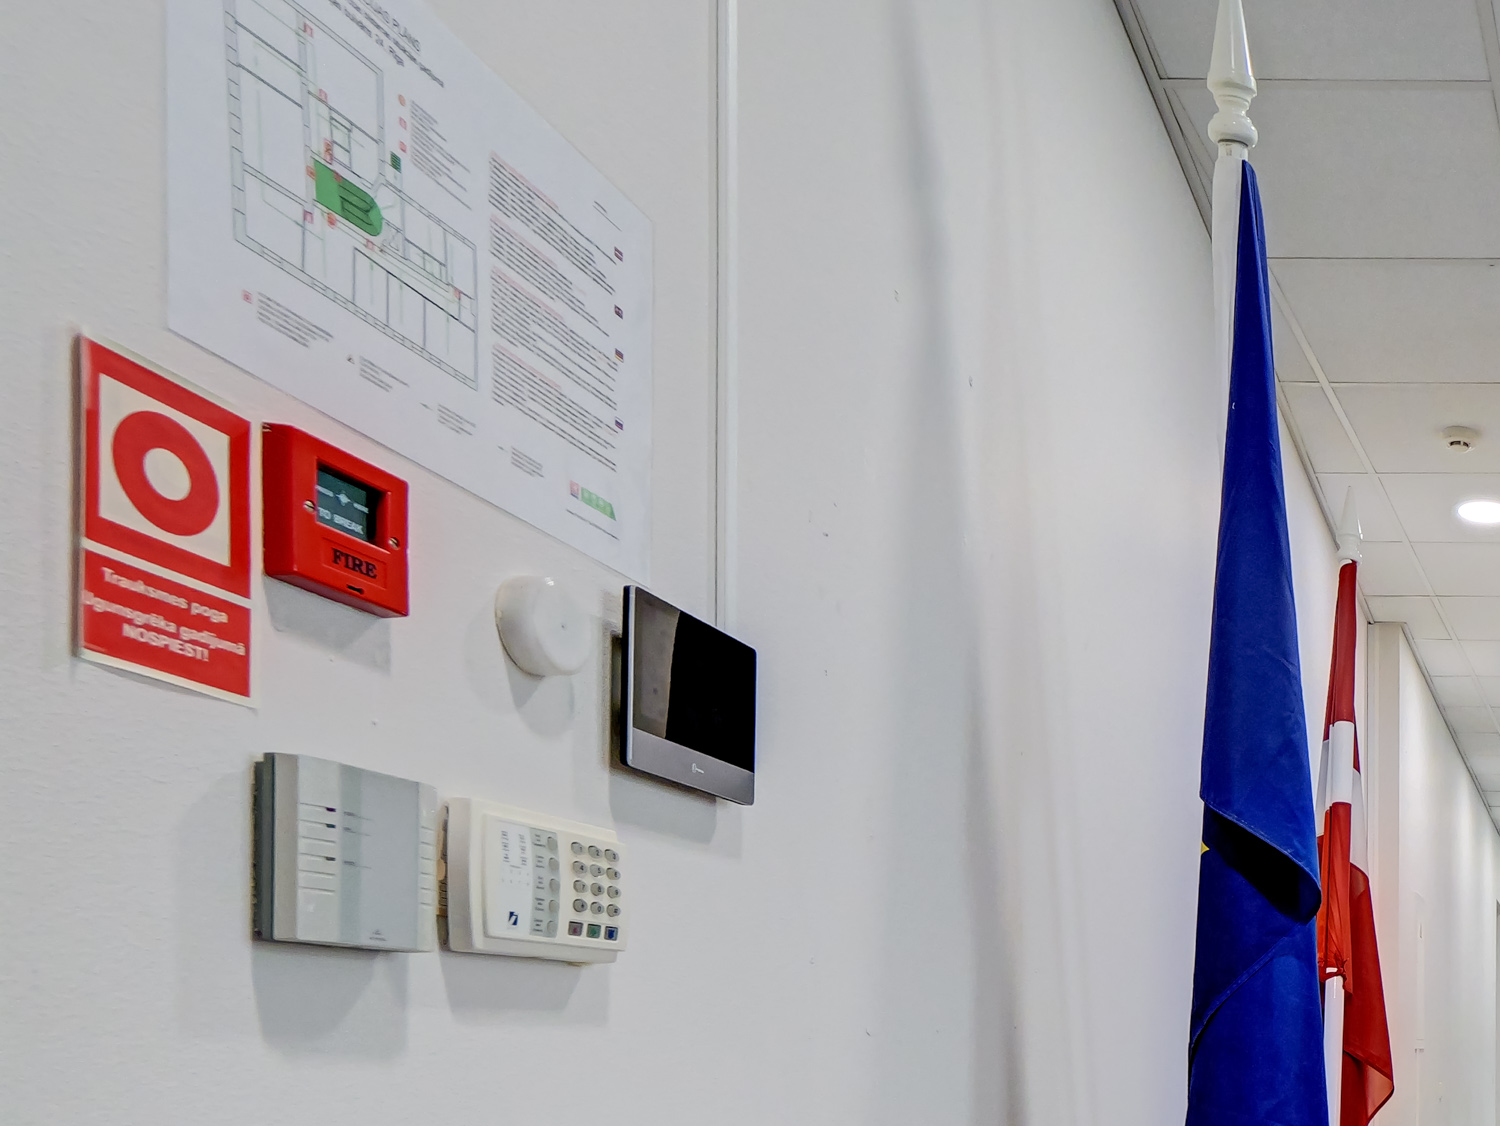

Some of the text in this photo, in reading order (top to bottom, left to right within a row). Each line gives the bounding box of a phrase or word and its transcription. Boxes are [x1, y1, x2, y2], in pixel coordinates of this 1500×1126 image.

[318, 507, 364, 535] TO BREAK
[332, 547, 377, 579] FIRE
[102, 566, 228, 623] Trauksmes poga
[122, 623, 209, 662] NOSPIEST!
